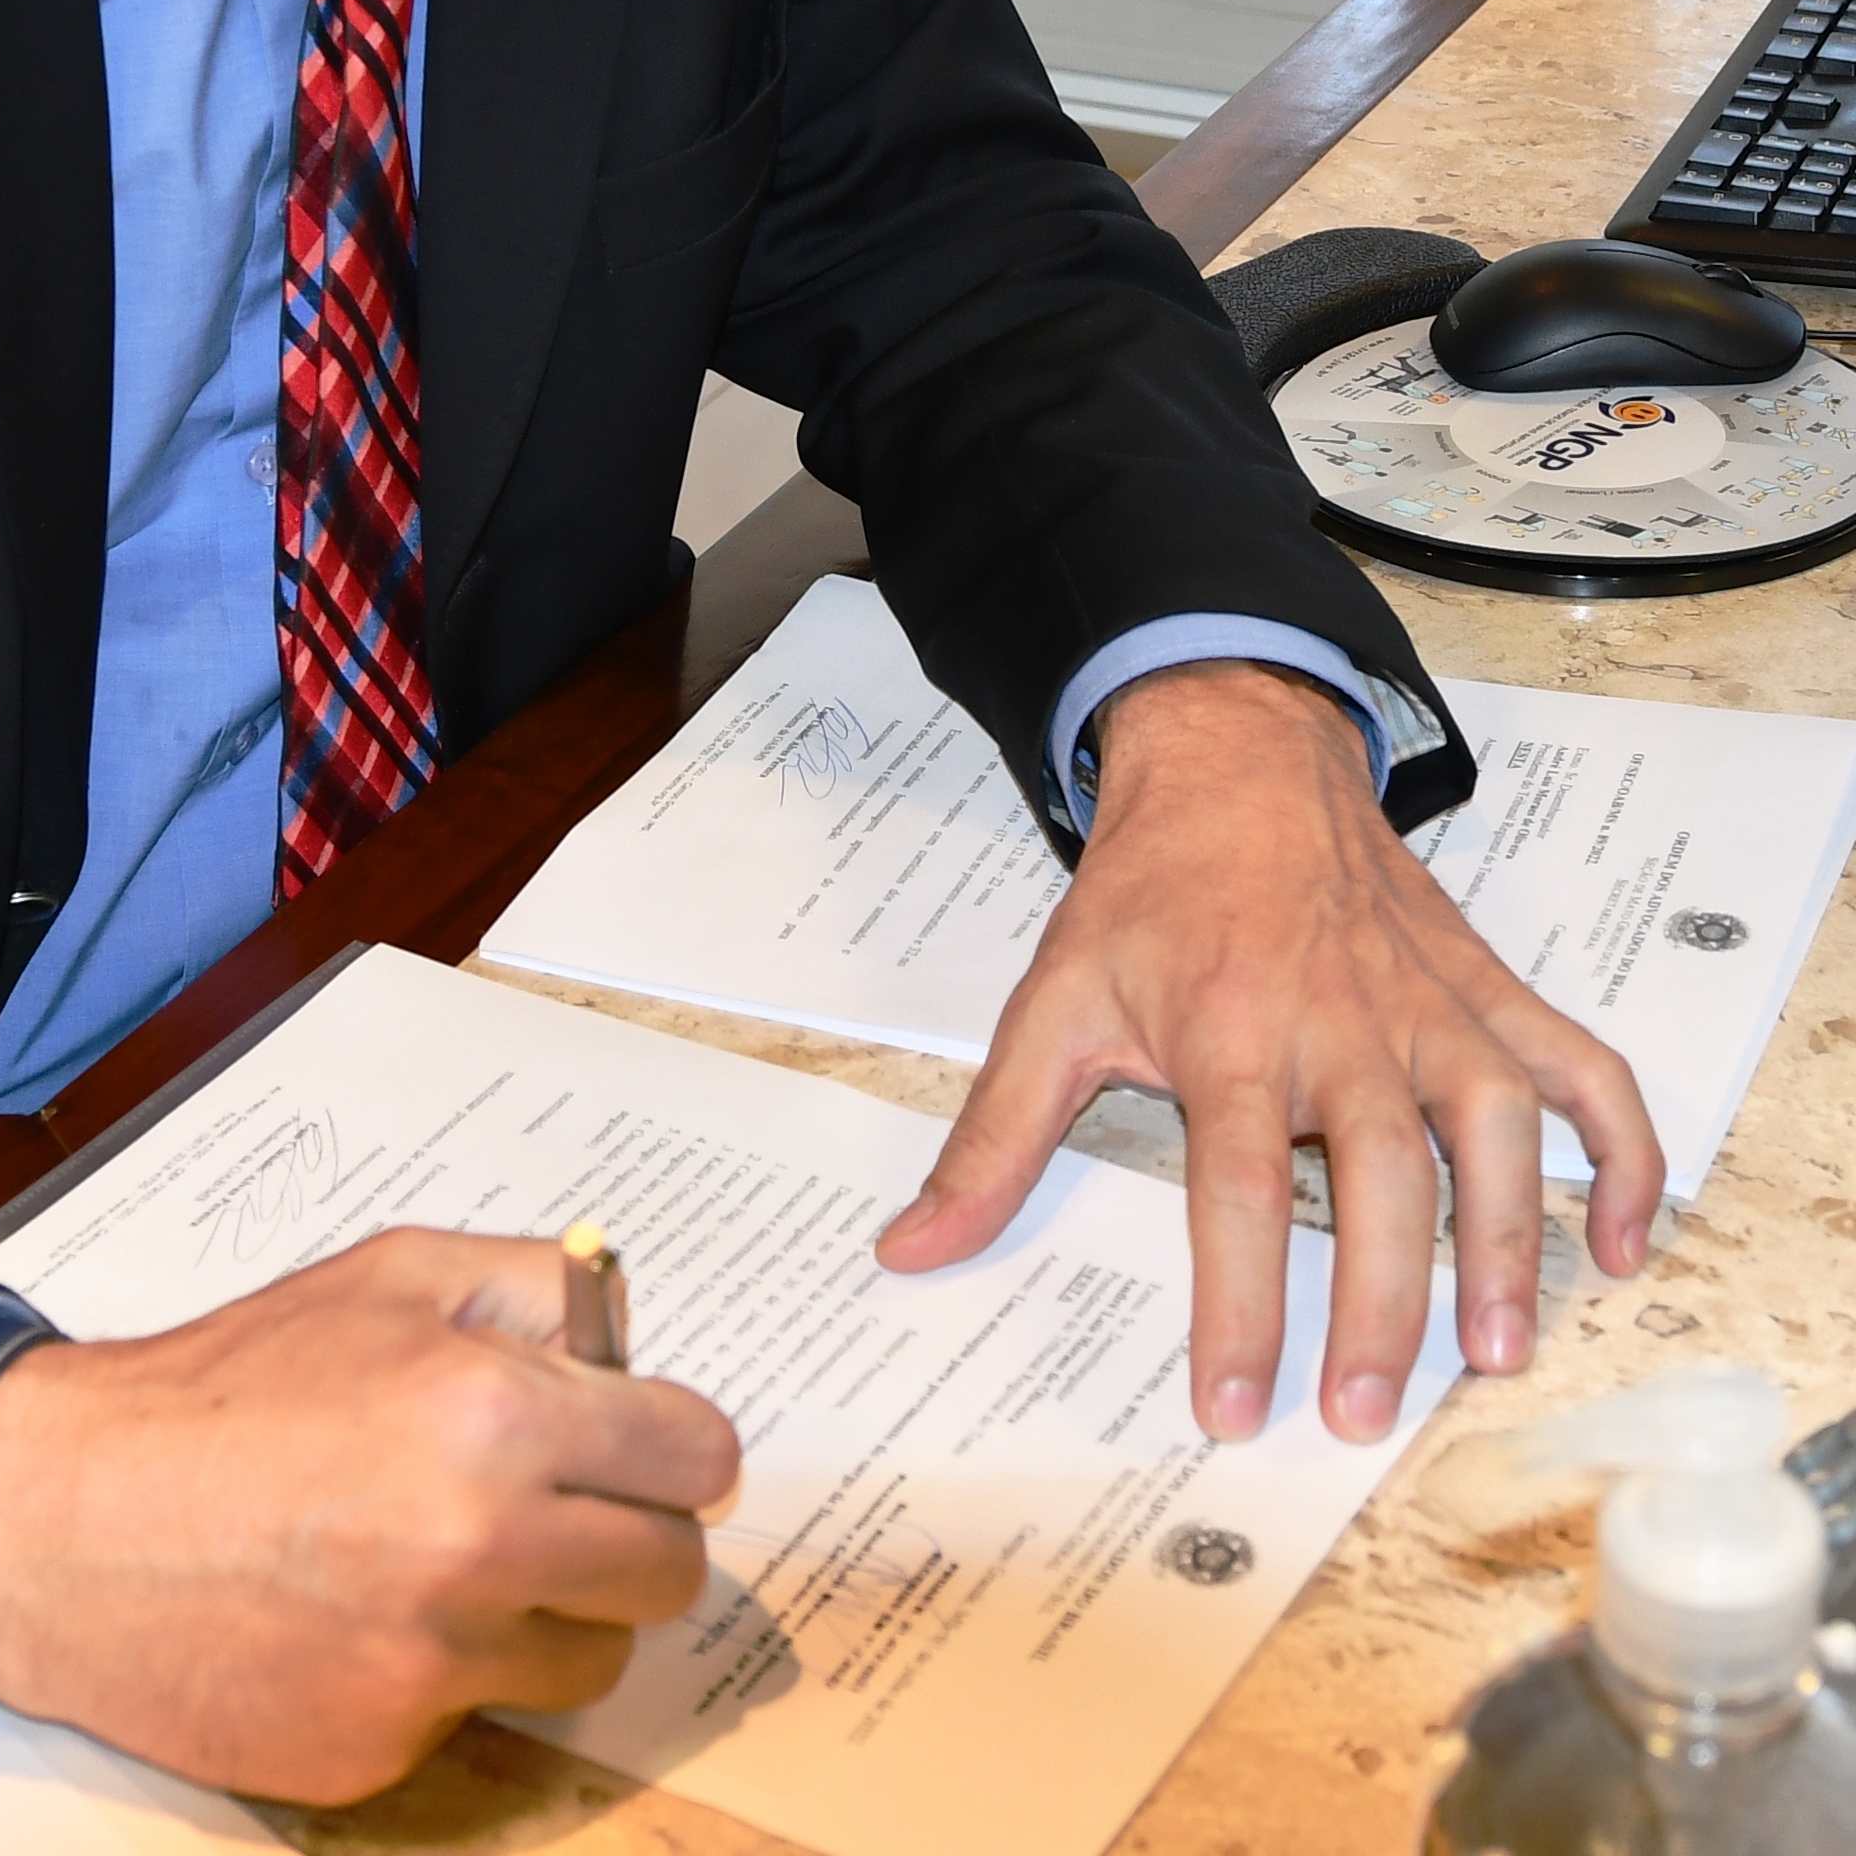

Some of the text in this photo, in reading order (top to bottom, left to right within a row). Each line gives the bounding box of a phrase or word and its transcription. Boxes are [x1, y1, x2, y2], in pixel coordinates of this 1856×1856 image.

[1521, 421, 1622, 471] NGP
[1506, 740, 1534, 769] NESTA
[1597, 830, 1691, 1007] ORDEM DOS ADVOGADOS DO BRASIL
